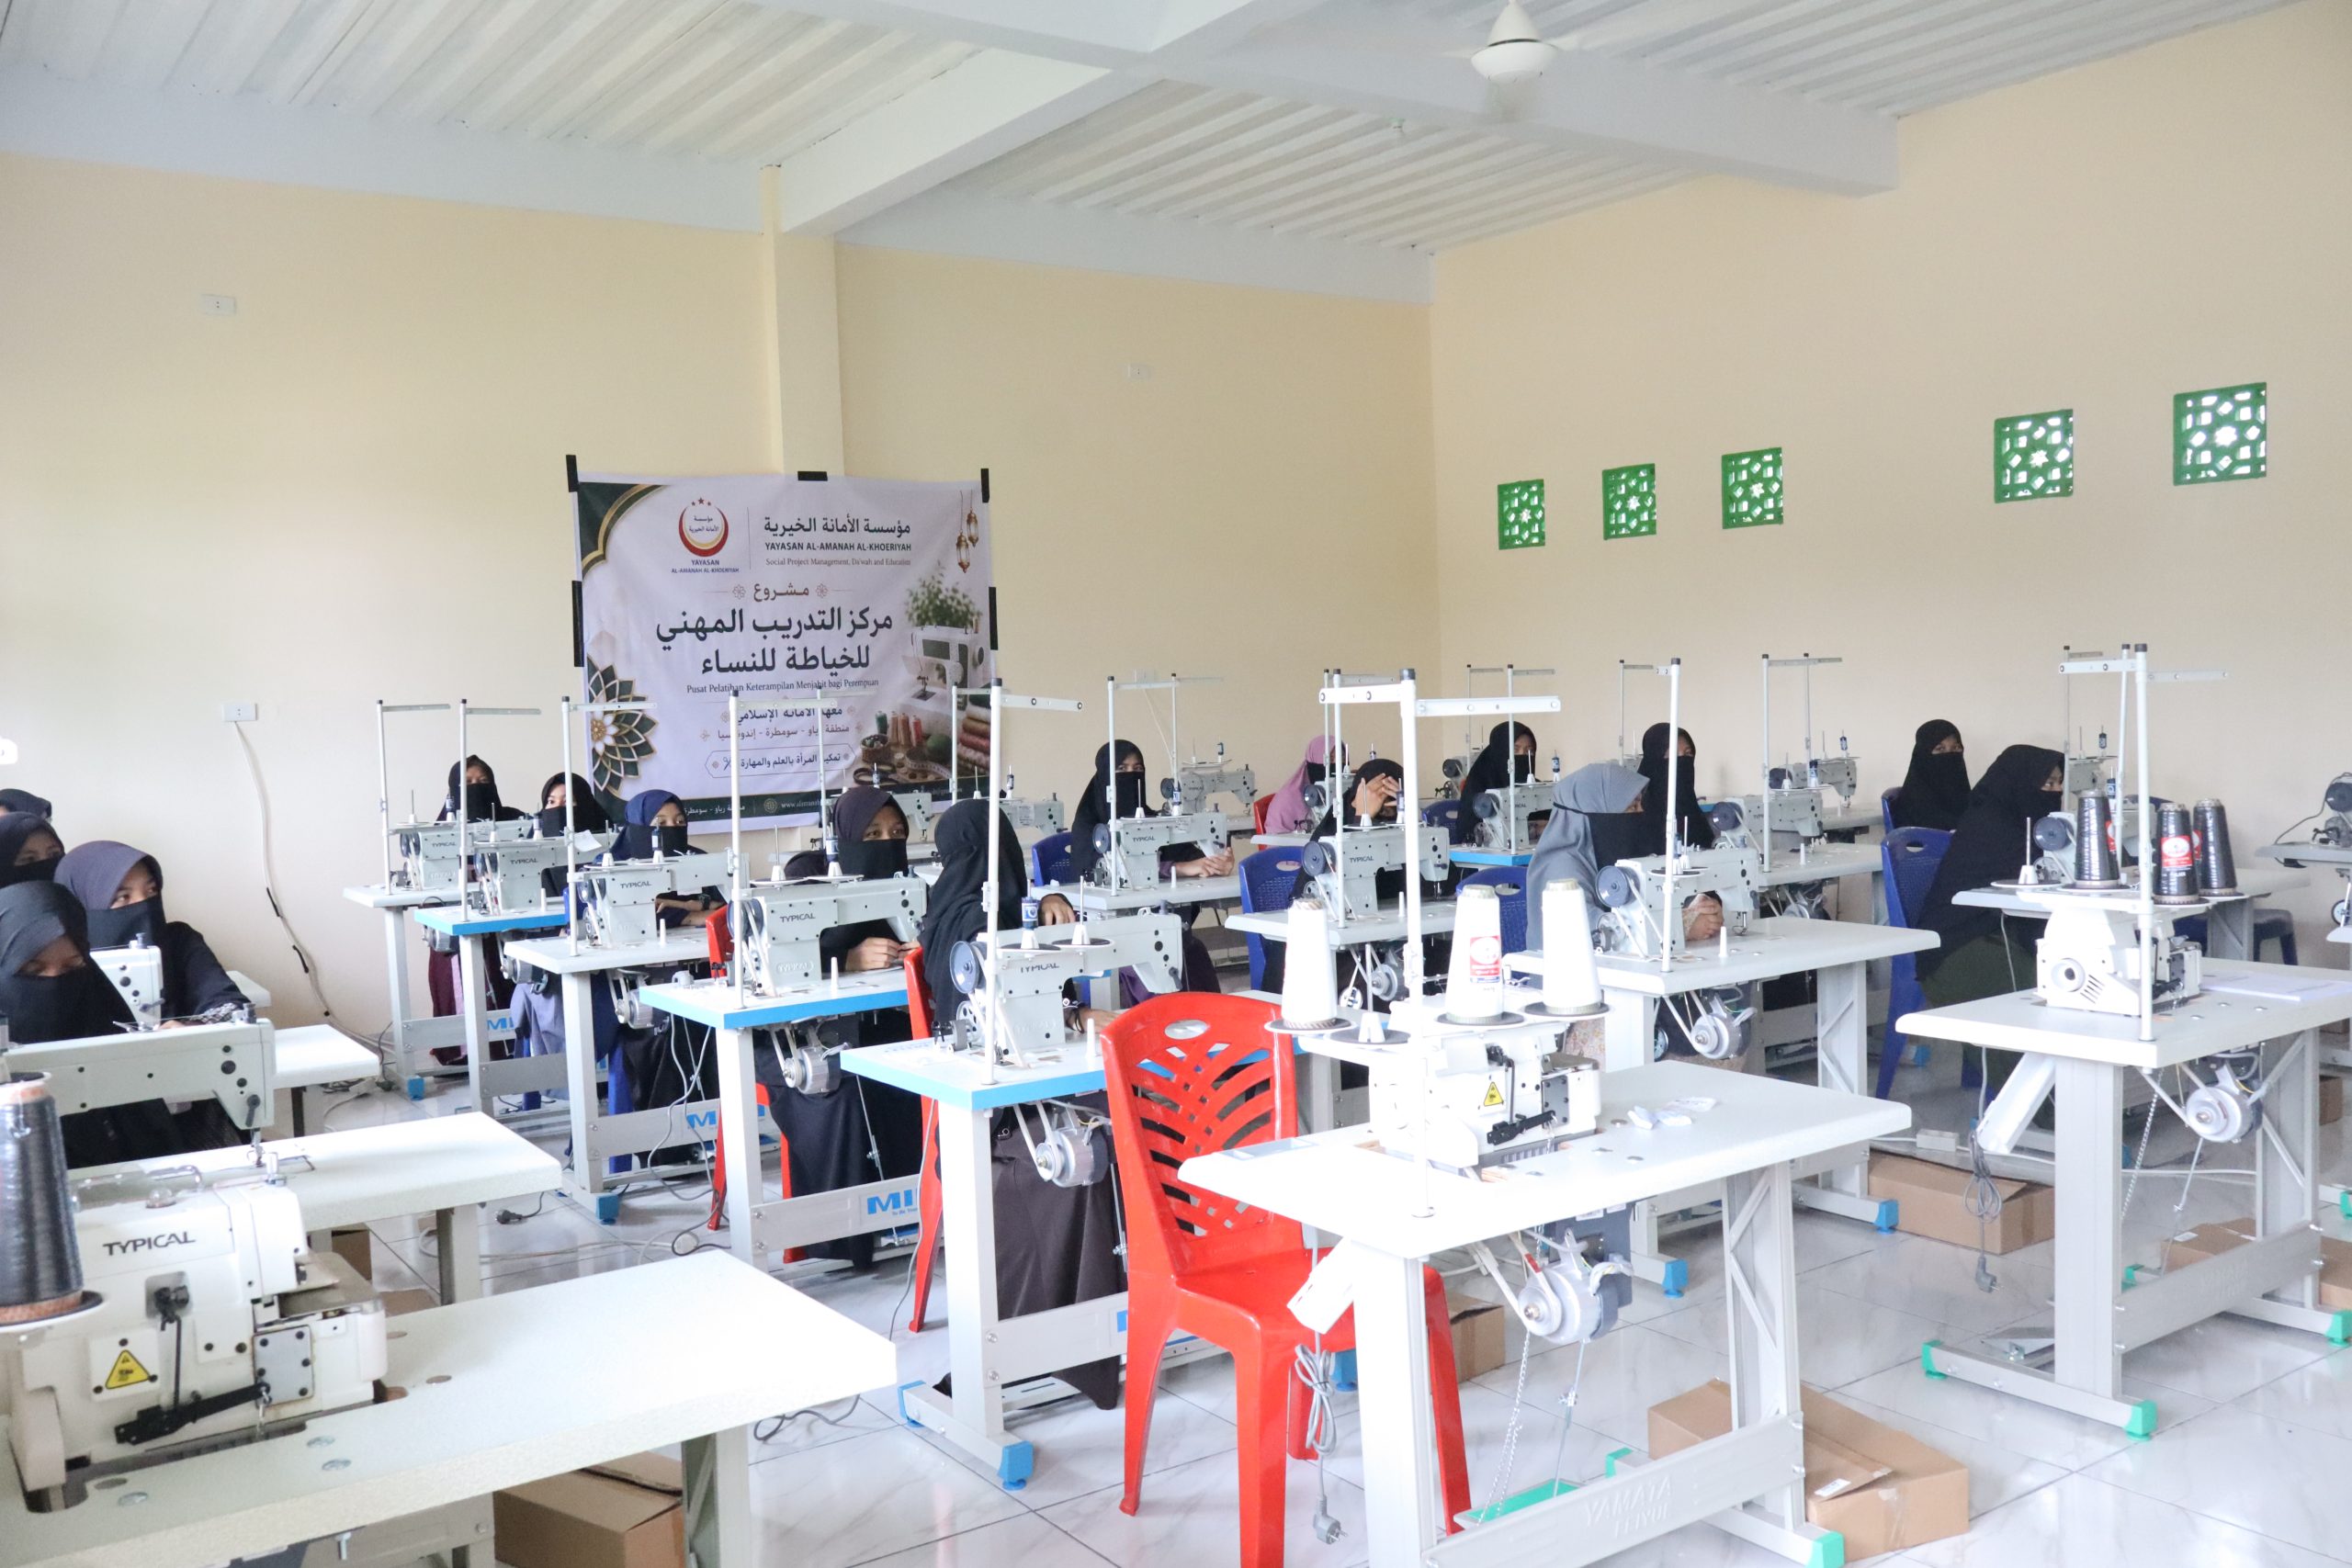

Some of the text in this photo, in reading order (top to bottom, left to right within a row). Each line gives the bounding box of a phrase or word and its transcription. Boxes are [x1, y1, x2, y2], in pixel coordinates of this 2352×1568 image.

[764, 513, 910, 538] مؤسسة الأمانة الخيرية
[764, 542, 911, 551] YAYASAN AL-AMANAH AL-KHOERIYAH
[765, 558, 786, 566] Social
[787, 558, 809, 567] Project
[874, 558, 885, 566] and
[753, 582, 809, 603] مشروع
[656, 606, 893, 651] مركز التدريب المهني
[701, 645, 870, 677] للخياطة للنساء
[686, 684, 707, 694] Pusat
[708, 683, 744, 693] Pelatihan
[745, 681, 795, 692] Keterampilan
[828, 680, 842, 690] bagi
[843, 679, 878, 689] Perempuan
[765, 728, 797, 738] سومطرة
[773, 755, 794, 767] بالعلم
[796, 752, 817, 765] المرأة
[1349, 855, 1374, 863] TYPICAL
[619, 881, 653, 889] TYPICAL
[779, 912, 816, 923] TYPICAL
[102, 1231, 197, 1257] TYPICAL
